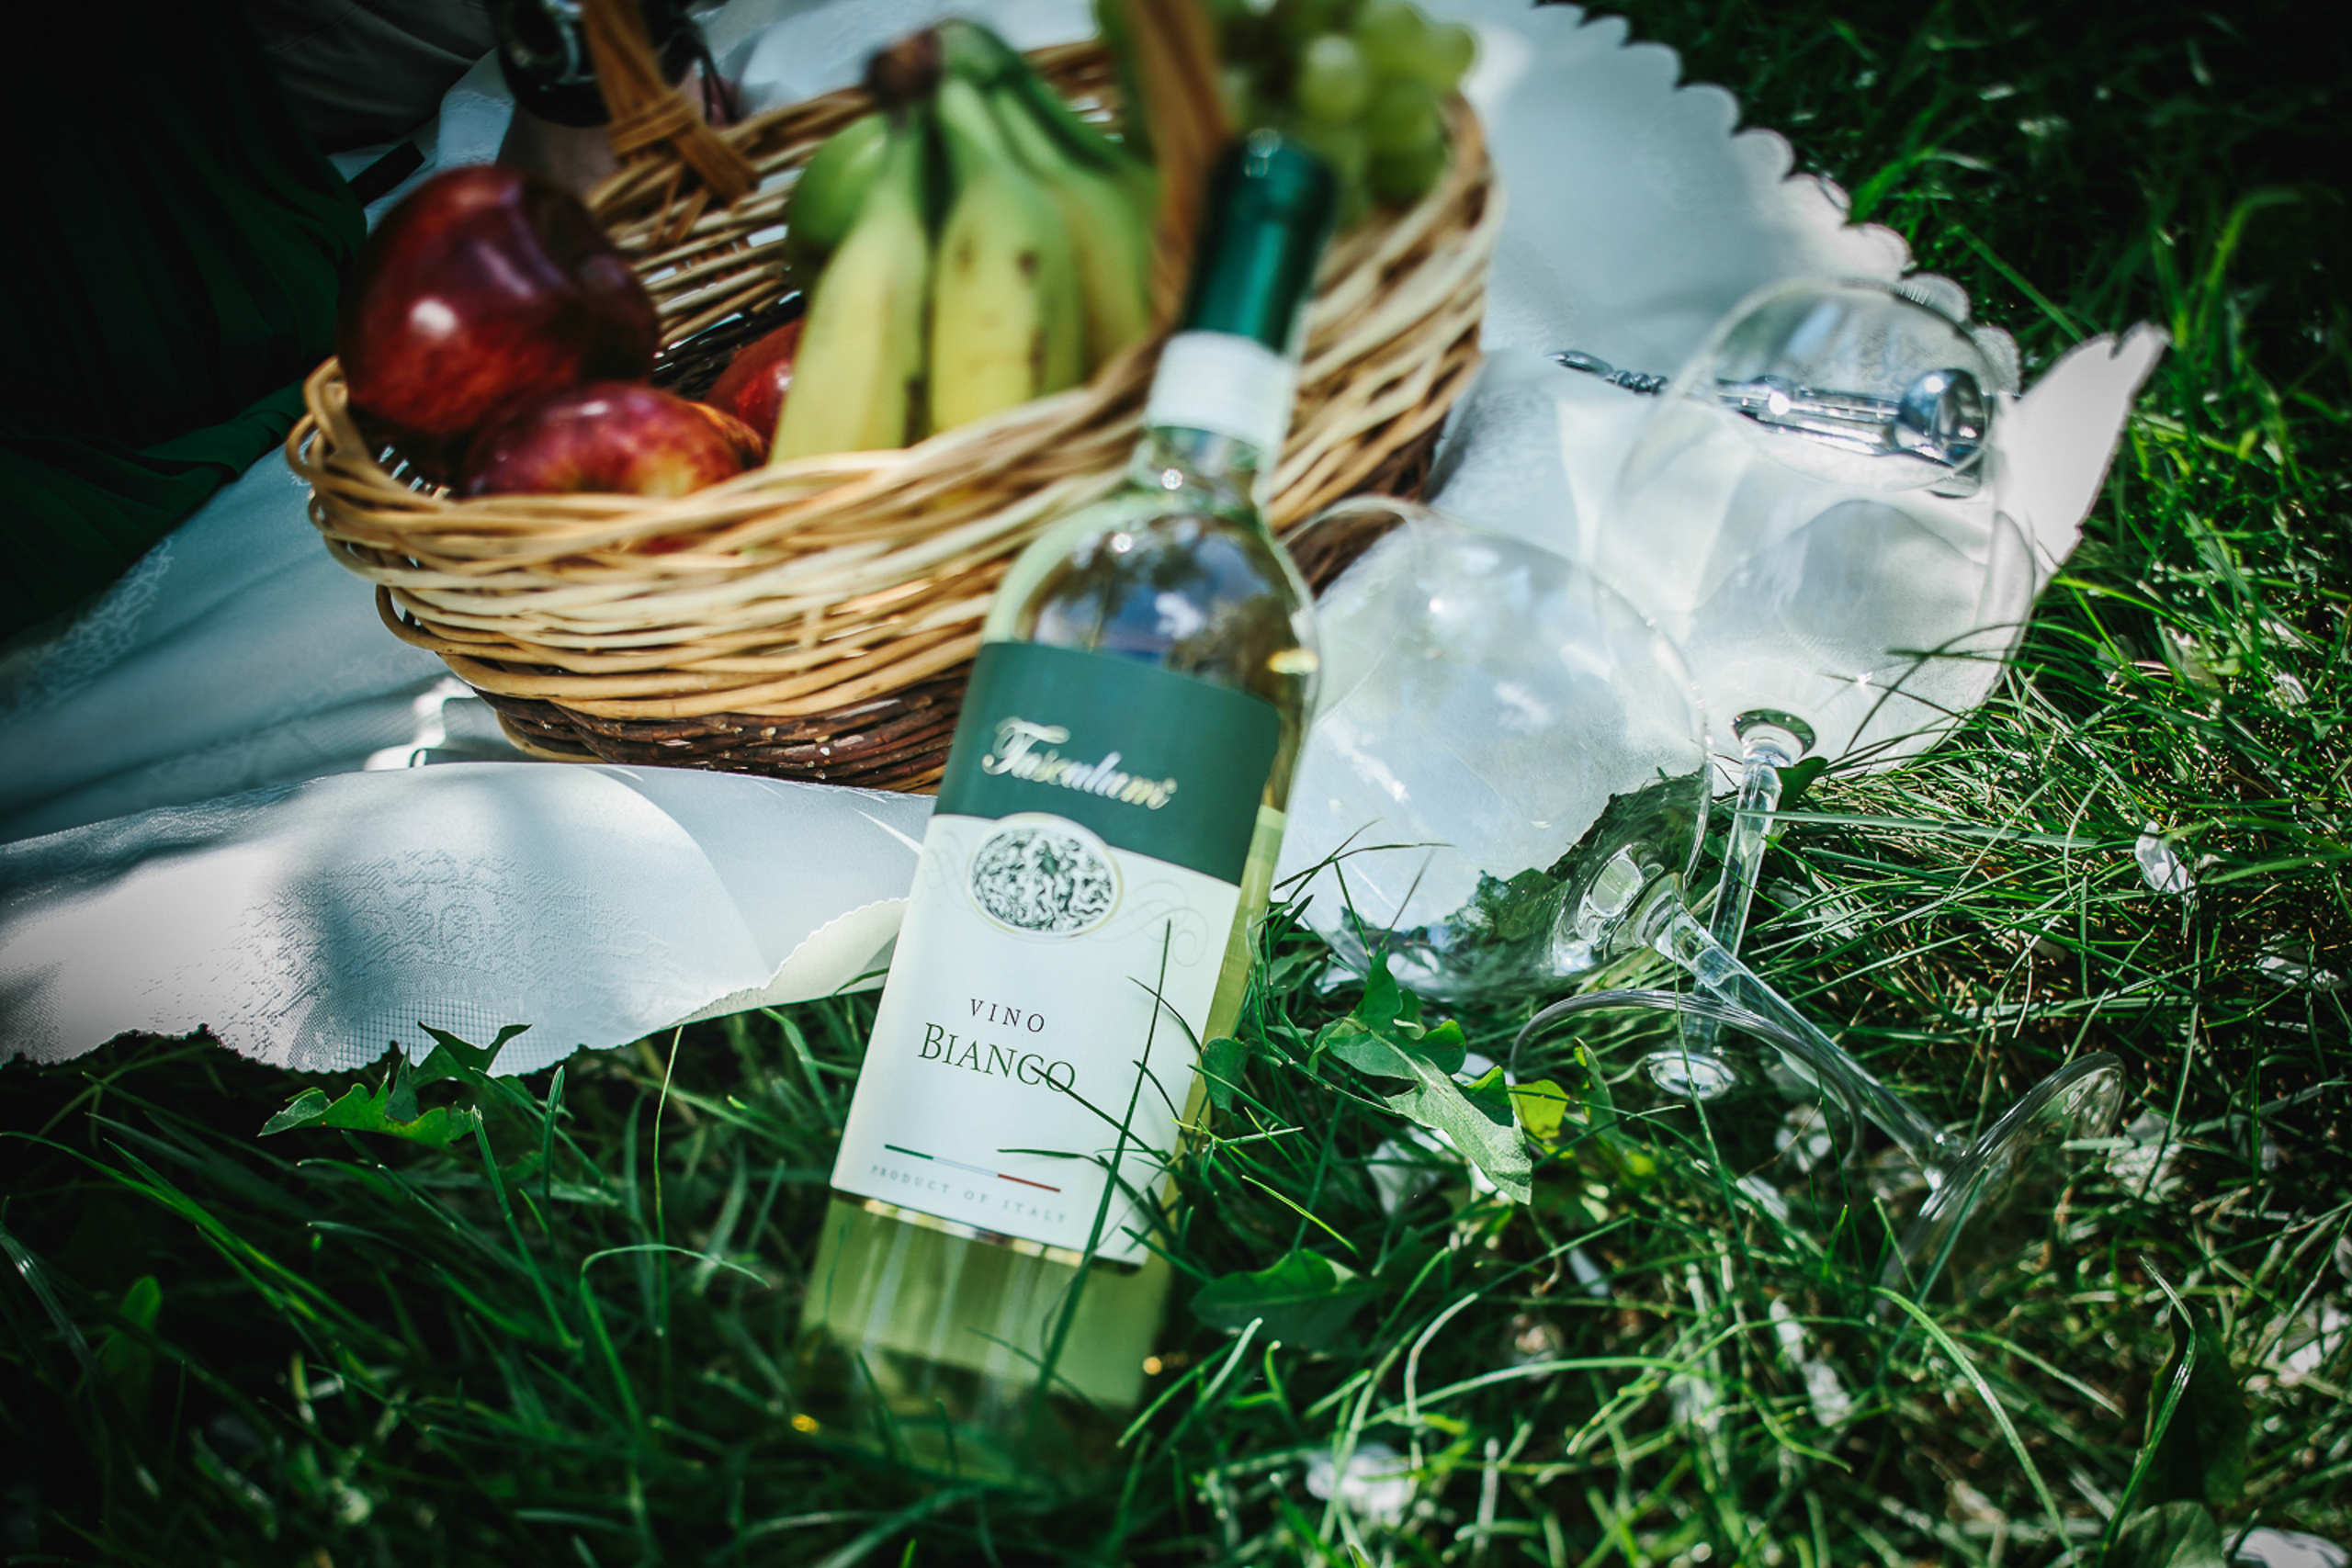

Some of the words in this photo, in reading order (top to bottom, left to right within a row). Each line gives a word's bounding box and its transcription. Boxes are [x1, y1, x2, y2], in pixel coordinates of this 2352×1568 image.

[970, 998, 1045, 1032] VINO
[917, 1021, 1076, 1092] BIANCO
[870, 1165, 951, 1194] PRODUCT
[964, 1190, 989, 1204] OF
[1002, 1200, 1067, 1224] ITALY
